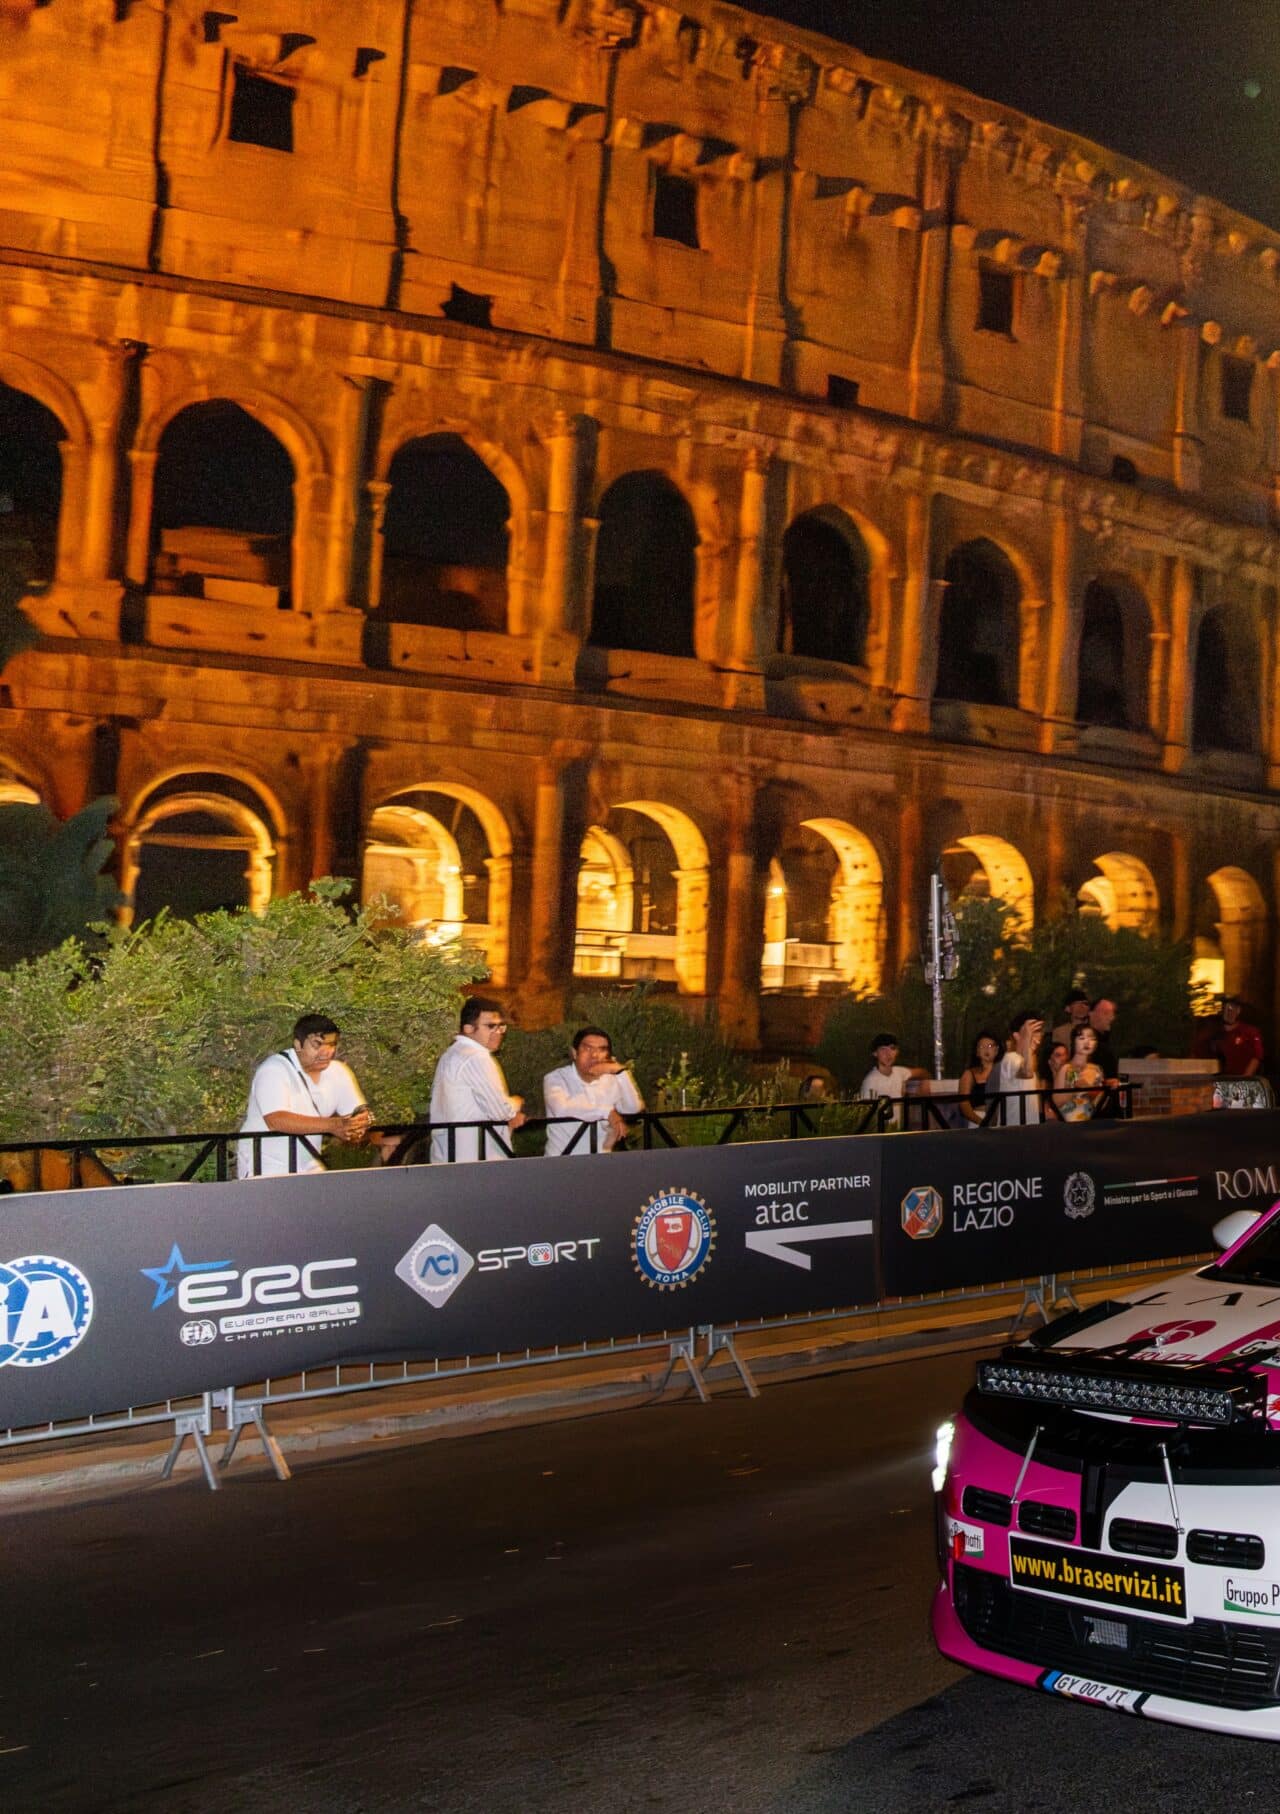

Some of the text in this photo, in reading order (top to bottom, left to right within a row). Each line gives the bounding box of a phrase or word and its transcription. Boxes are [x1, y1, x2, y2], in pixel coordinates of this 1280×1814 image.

[745, 1175, 871, 1198] MOBILITY PARTNER
[953, 1177, 1042, 1206] REGIONE
[637, 1196, 710, 1248] AUTOMOBILE CLUB
[755, 1200, 809, 1225] atac
[953, 1205, 1013, 1232] LAZIO
[421, 1254, 459, 1279] ACI
[655, 1271, 689, 1282] ROMA
[178, 1257, 360, 1314] ERC
[224, 1306, 356, 1329] EUROPEAN RALLY
[183, 1322, 214, 1344] FIA
[225, 1319, 358, 1343] CHAMPIONSHIP
[1013, 1553, 1182, 1606] www.braservizi.it
[1225, 1578, 1269, 1607] Gruppo
[1057, 1677, 1128, 1703] GY 007 JT
